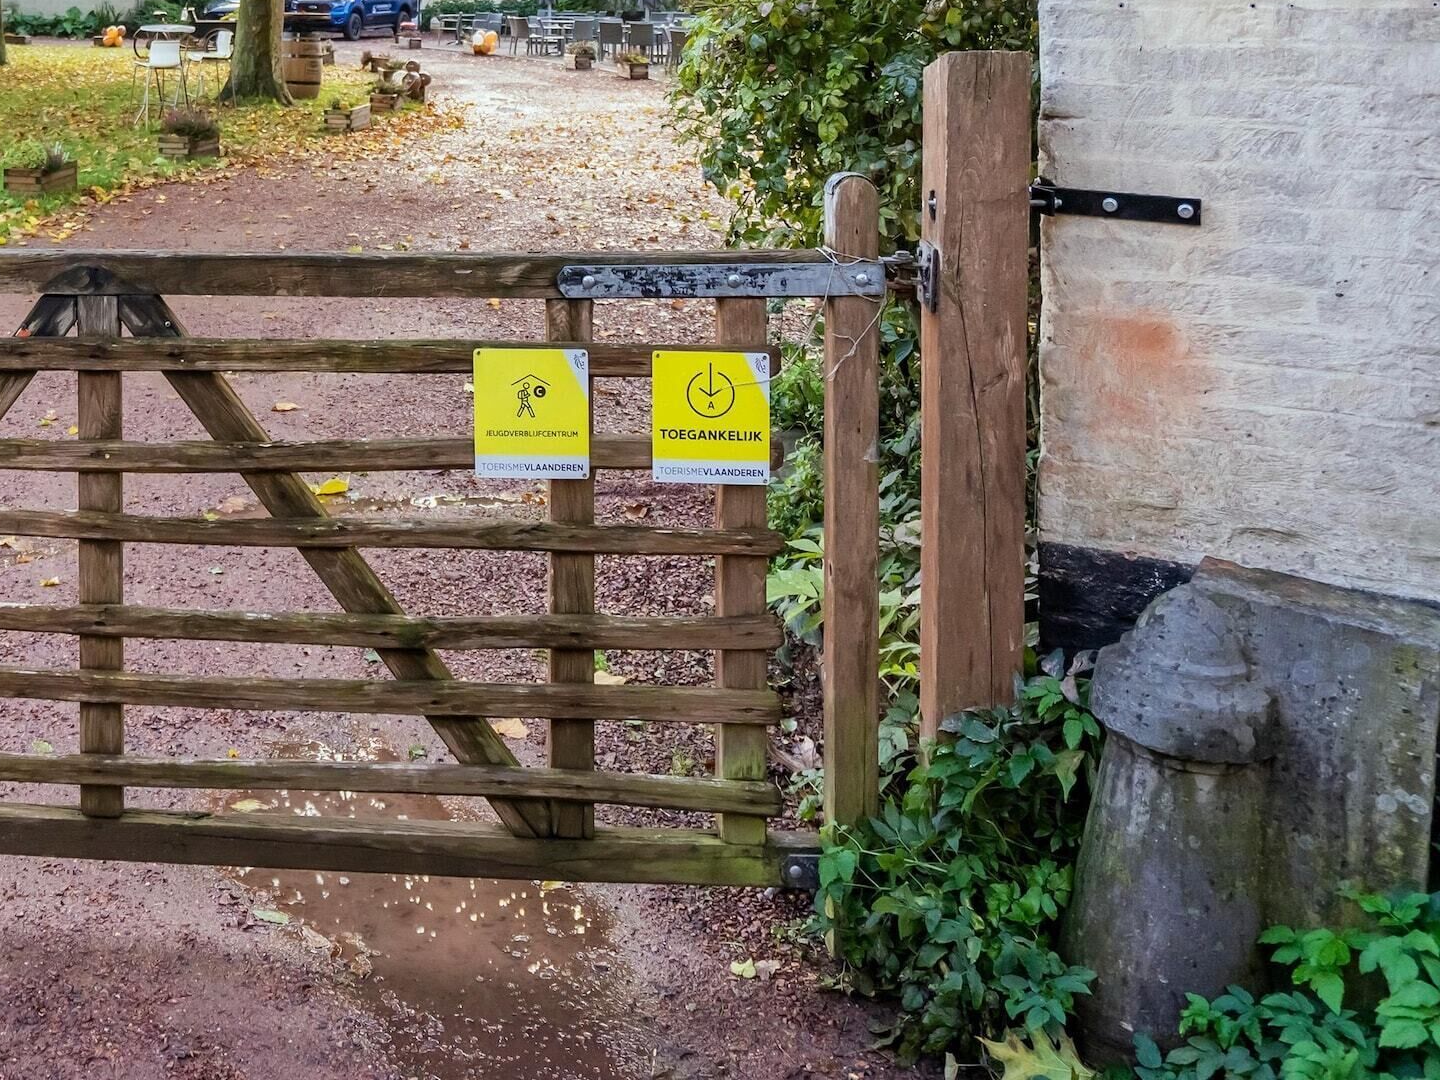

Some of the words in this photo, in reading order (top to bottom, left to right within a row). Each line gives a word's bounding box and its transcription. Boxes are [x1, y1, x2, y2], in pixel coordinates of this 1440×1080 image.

[707, 401, 715, 410] A
[486, 430, 579, 438] JEUGDVERBLIJFCENTRUM
[660, 429, 762, 442] TOEGANKELIJK
[481, 462, 584, 472] TOERISMEVLAANDEREN
[659, 466, 764, 477] TOERISMEVLAANDEREN
